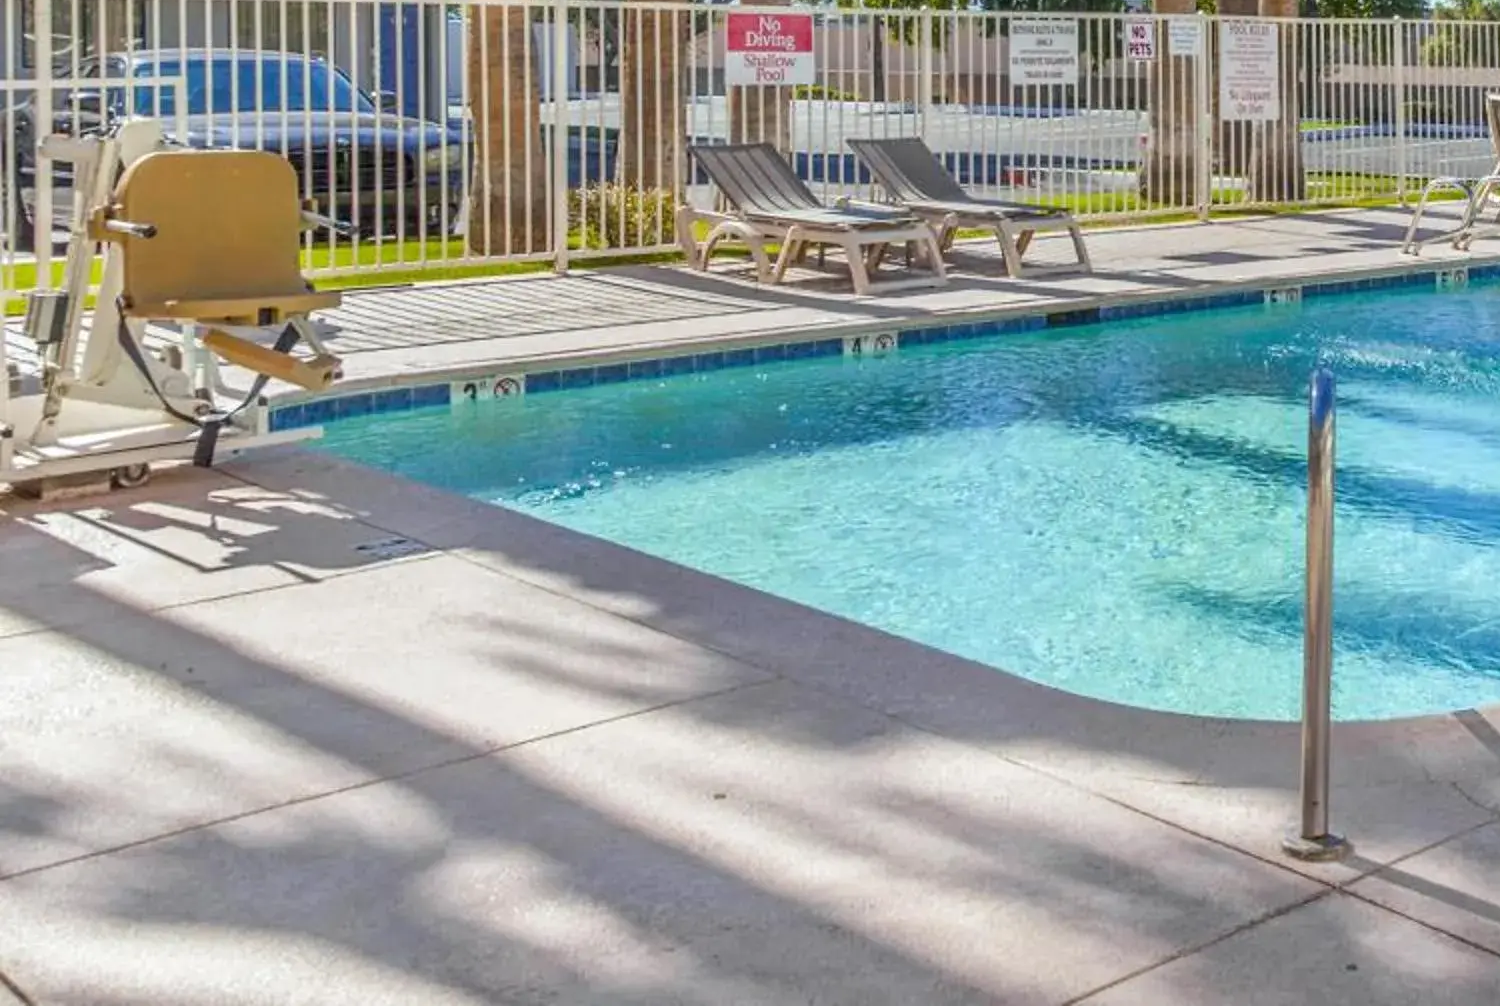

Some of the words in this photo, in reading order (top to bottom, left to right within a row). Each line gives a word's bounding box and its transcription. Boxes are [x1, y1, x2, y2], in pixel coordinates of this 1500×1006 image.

[759, 16, 781, 31] No
[1132, 26, 1146, 39] NO
[744, 31, 796, 51] Diving
[1129, 42, 1152, 55] PETS
[743, 54, 797, 67] Shallow
[756, 68, 785, 82] Pool
